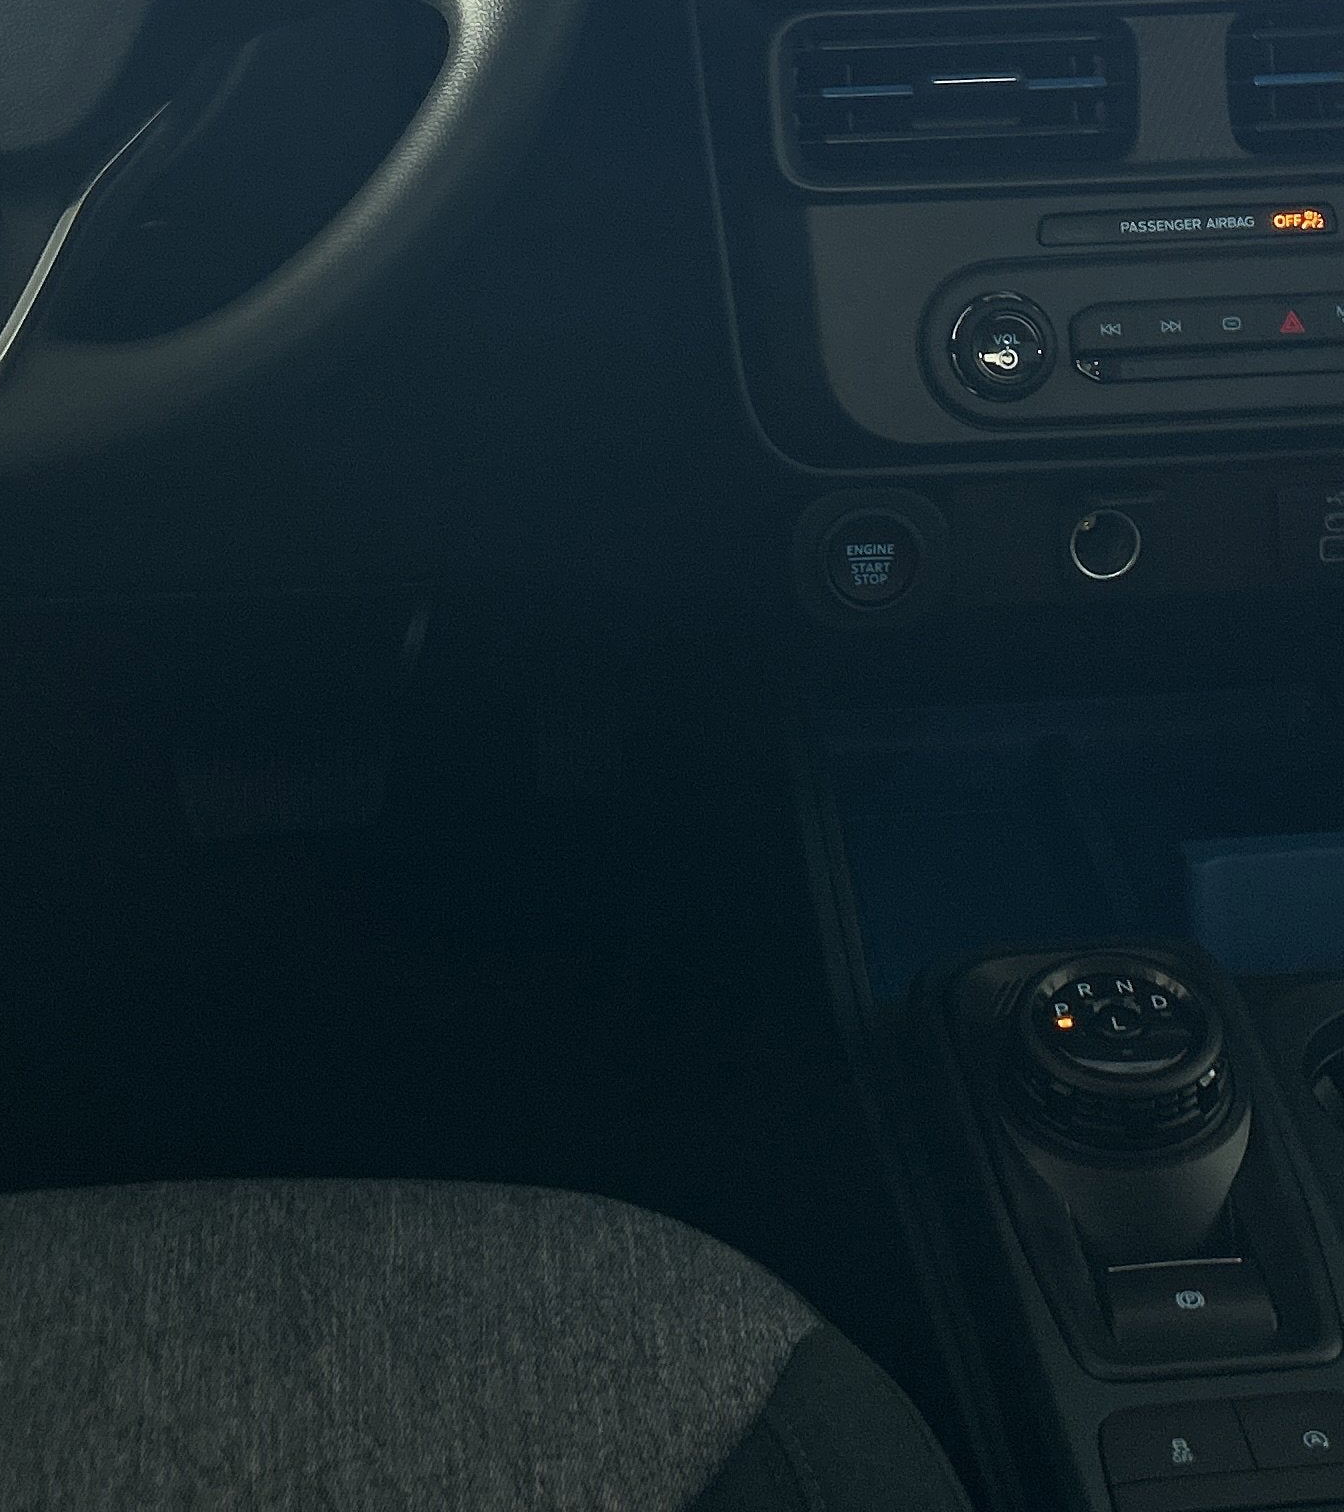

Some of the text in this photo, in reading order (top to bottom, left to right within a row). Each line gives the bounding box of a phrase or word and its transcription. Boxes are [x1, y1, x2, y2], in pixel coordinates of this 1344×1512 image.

[1120, 214, 1302, 234] PASSENGER AIRBAG OFF
[993, 333, 1021, 345] VOL
[847, 544, 895, 556] ENGINE
[851, 562, 890, 574] START
[854, 573, 888, 586] STOP
[1055, 979, 1167, 1017] P R N D
[1111, 1016, 1127, 1030] L
